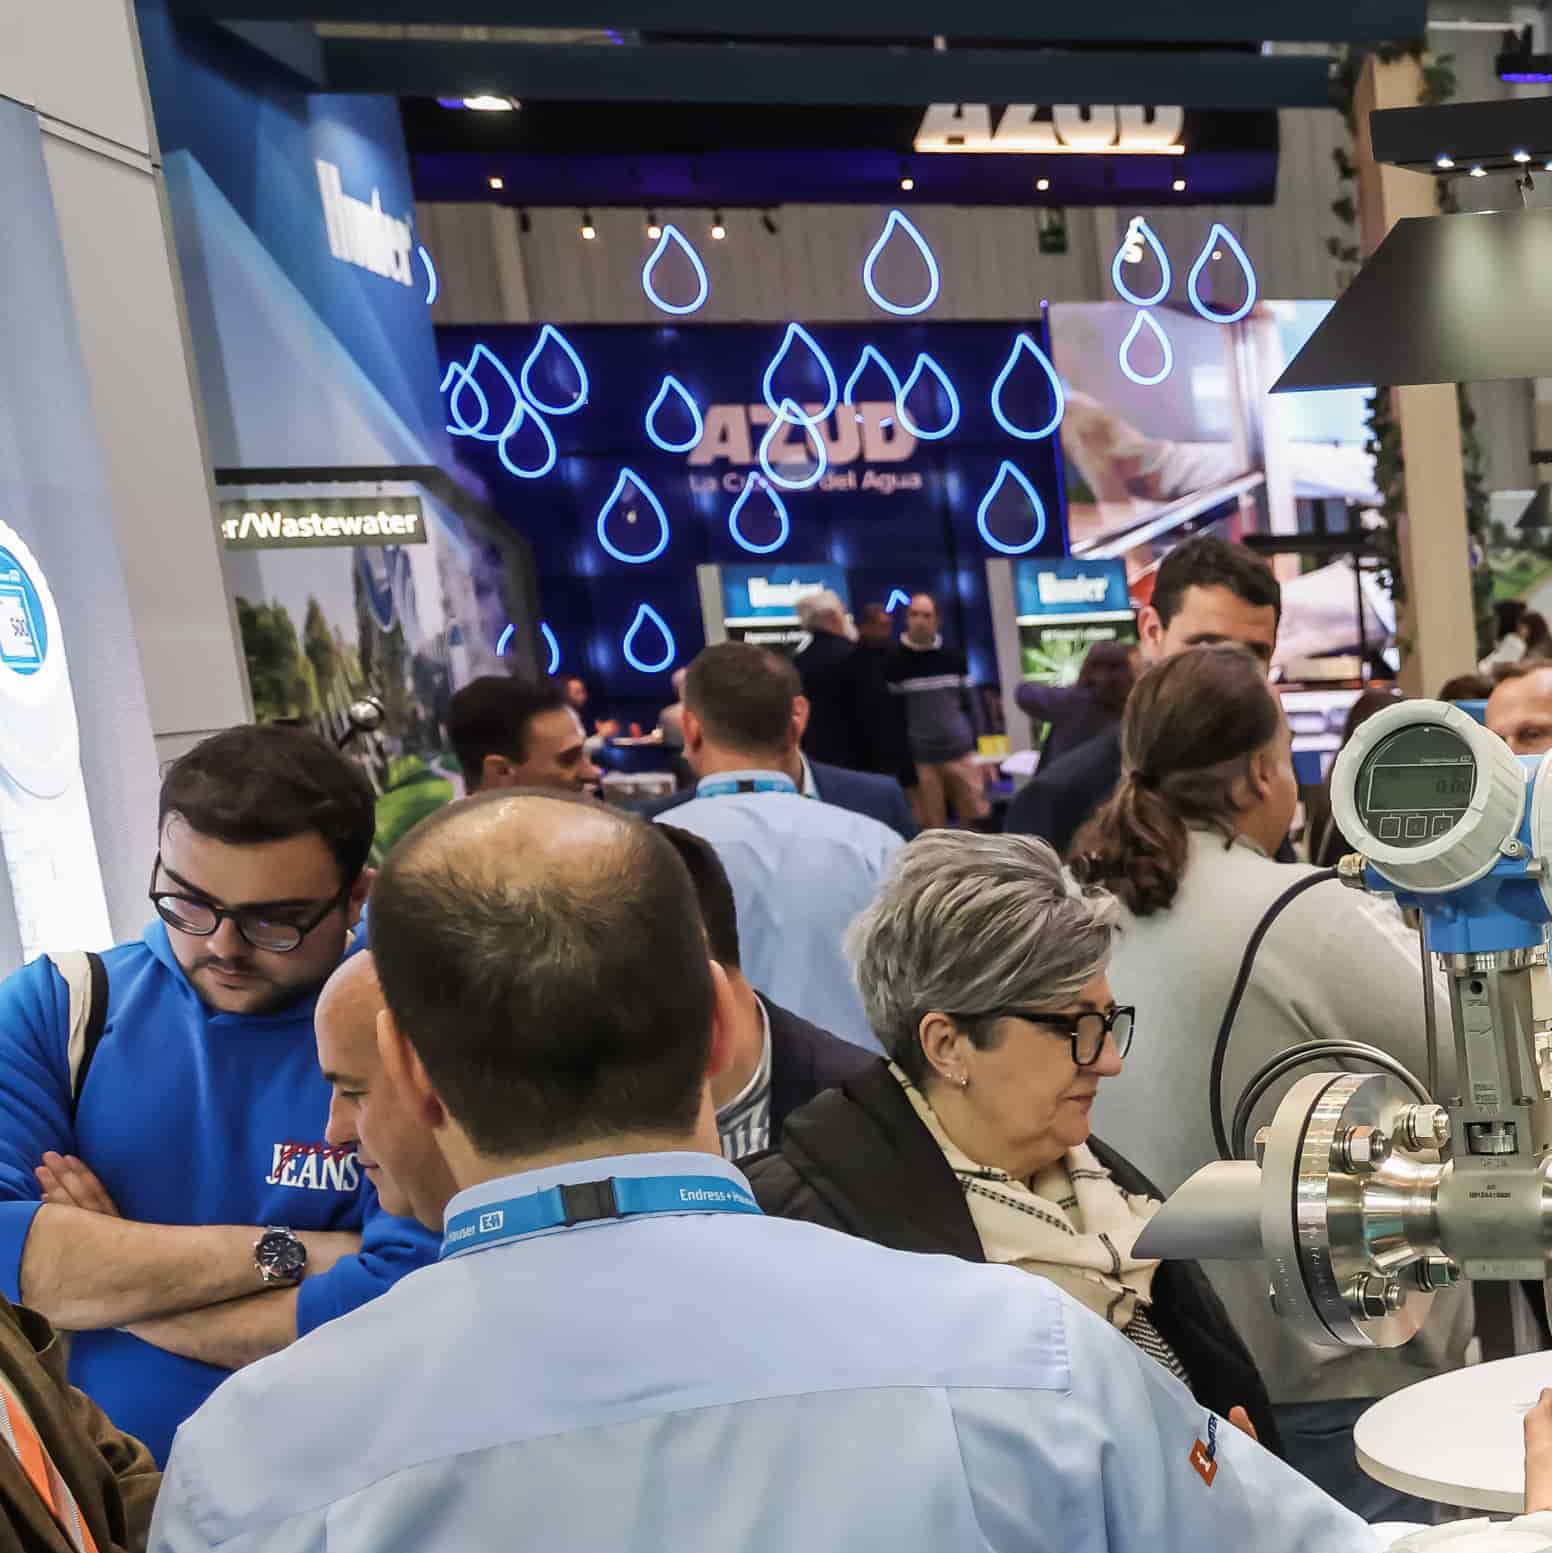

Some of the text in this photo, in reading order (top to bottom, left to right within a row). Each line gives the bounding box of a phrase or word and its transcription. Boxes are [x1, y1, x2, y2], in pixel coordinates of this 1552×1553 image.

[913, 103, 1184, 153] AZUD
[688, 402, 918, 464] AZUD
[861, 470, 923, 495] Agua
[265, 1143, 360, 1192] JEANS
